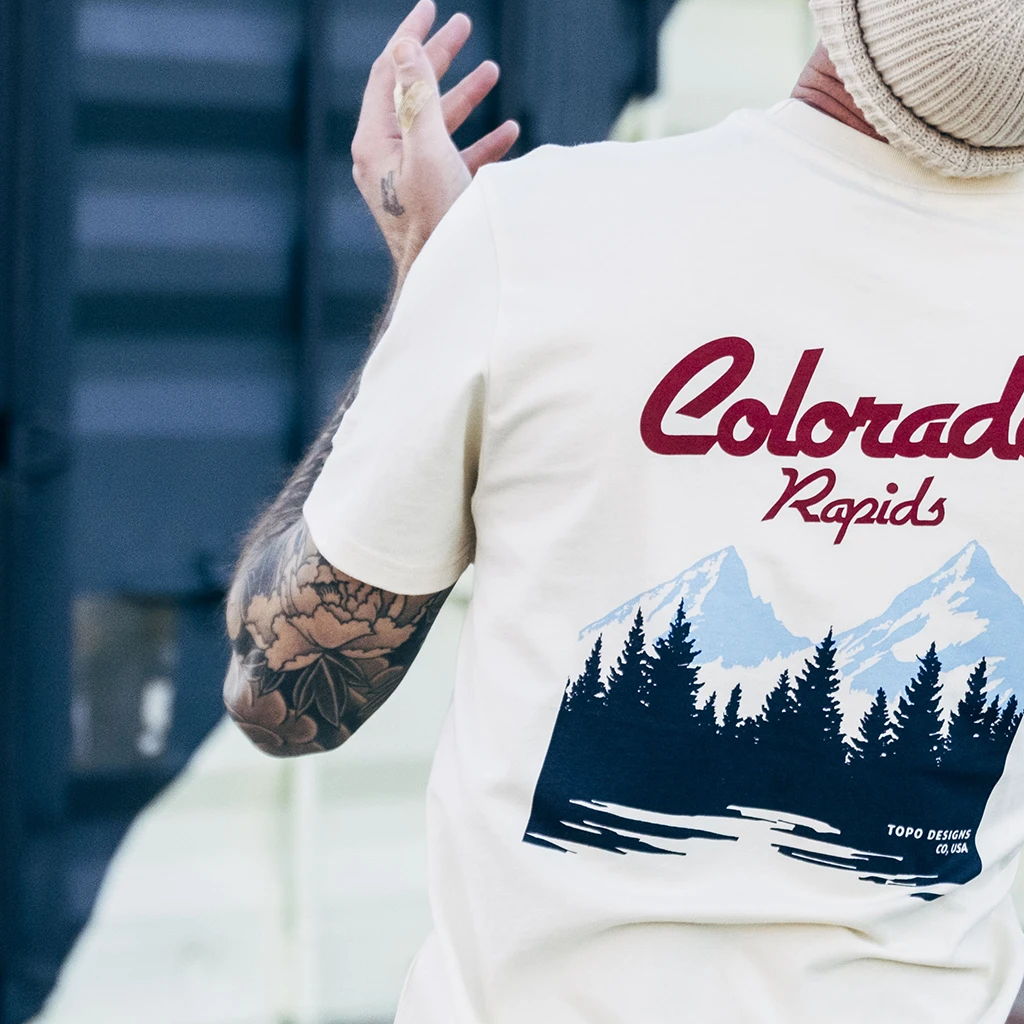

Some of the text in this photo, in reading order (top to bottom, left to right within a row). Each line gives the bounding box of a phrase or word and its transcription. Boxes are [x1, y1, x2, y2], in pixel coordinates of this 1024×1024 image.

[761, 467, 947, 545] Rapids
[887, 823, 971, 841] TOPO DESIGNS
[950, 842, 969, 854] USA
